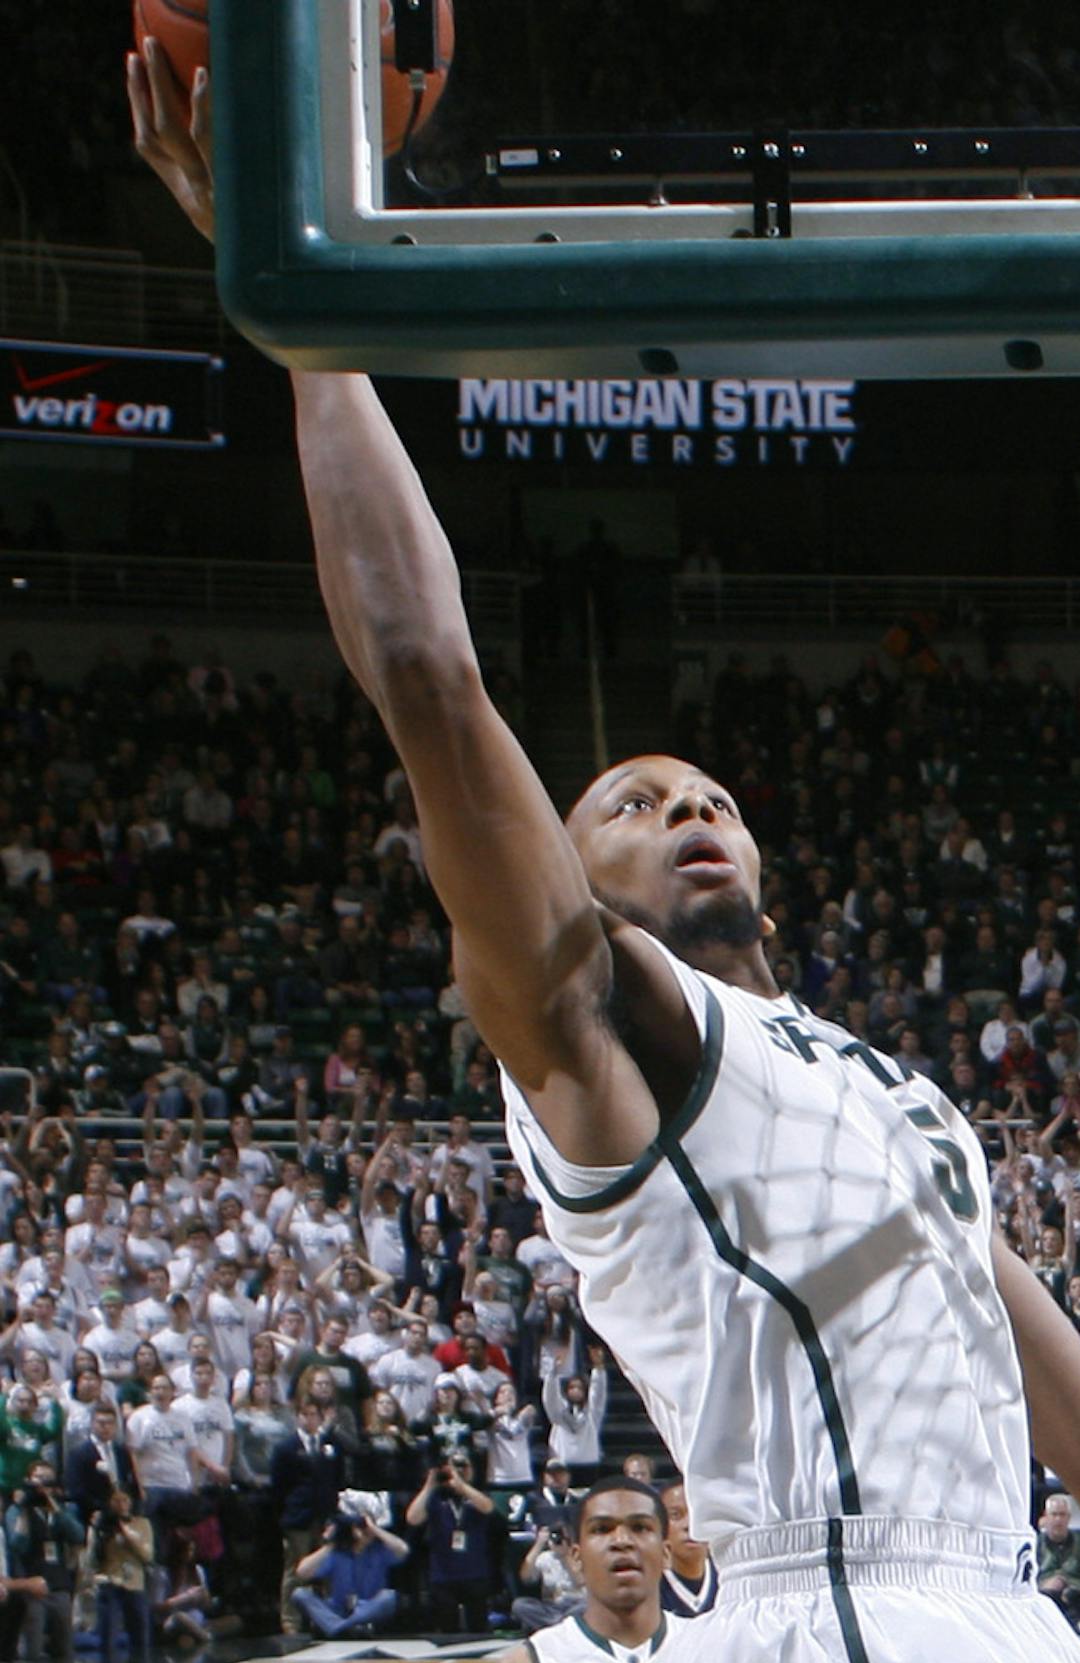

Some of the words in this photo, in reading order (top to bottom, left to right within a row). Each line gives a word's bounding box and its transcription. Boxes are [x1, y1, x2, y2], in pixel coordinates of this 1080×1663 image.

[14, 393, 171, 434] verizon
[458, 379, 700, 427] MICHIGAN
[712, 379, 856, 430] STATE
[460, 428, 854, 464] UNIVERSITY
